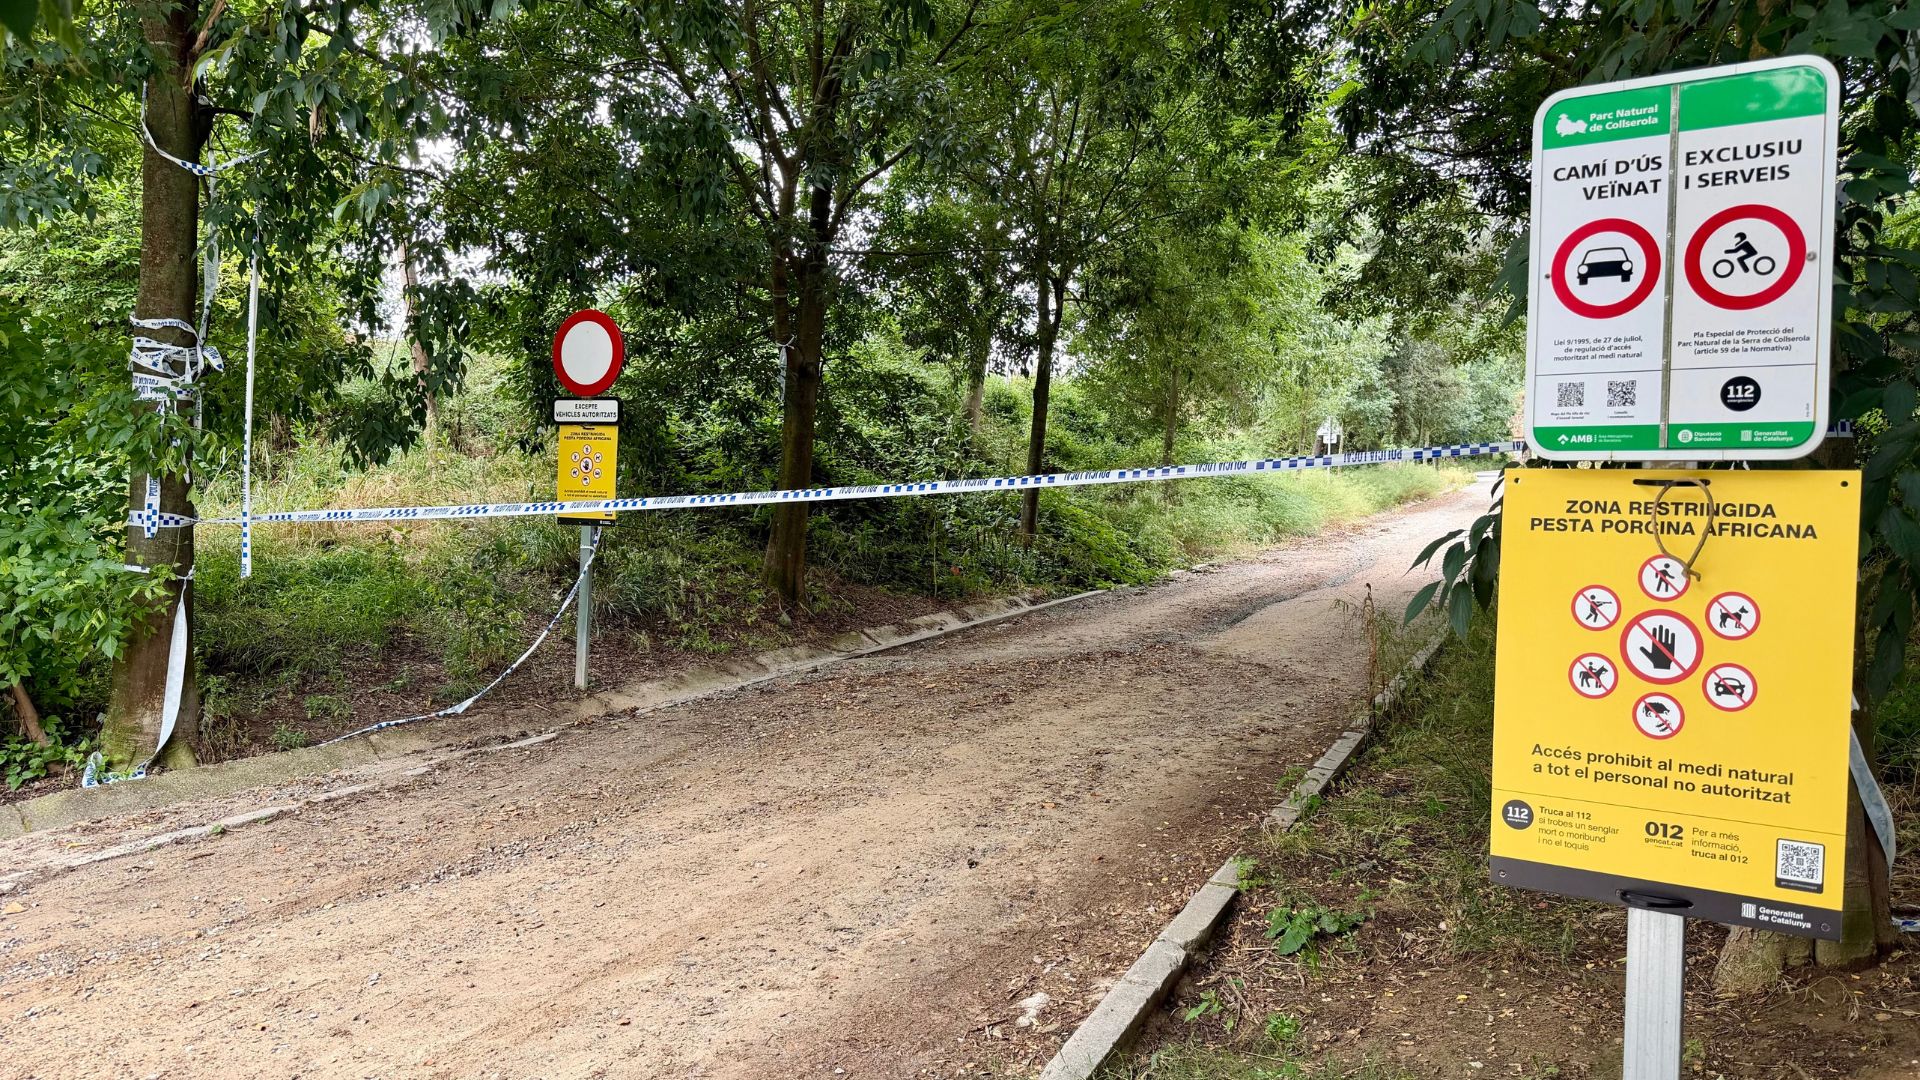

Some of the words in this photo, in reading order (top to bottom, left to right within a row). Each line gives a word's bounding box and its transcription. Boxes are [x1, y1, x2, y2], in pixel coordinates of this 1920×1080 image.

[1590, 112, 1613, 121] Parc
[1616, 104, 1658, 117] Natural
[1589, 123, 1603, 132] de
[1605, 115, 1658, 130] Collserola
[1685, 139, 1802, 167] EXCLUSIU
[1553, 158, 1607, 182] CAMÍ
[1684, 175, 1690, 190] I
[1698, 164, 1790, 189] SERVEIS
[1582, 178, 1662, 201] VEÏNAT
[1694, 339, 1720, 347] Natural
[1773, 334, 1810, 343] Collserola
[1706, 330, 1734, 339] Especial
[1747, 328, 1780, 336] Protecció
[1553, 354, 1589, 362] motoritzat
[1617, 351, 1642, 359] natural
[1574, 345, 1605, 354] regulació
[1694, 347, 1719, 355] (article
[1750, 344, 1792, 353] Normativa)
[1727, 385, 1755, 398] 112
[1570, 434, 1592, 443] AMB
[1566, 499, 1622, 514] ZONA
[1629, 501, 1776, 518] RESTRINGIDA
[1530, 517, 1594, 533] PESTA
[1601, 519, 1695, 536] PORCINA
[1703, 521, 1818, 540] AFRICANA
[1531, 743, 1582, 761] Accés
[1586, 751, 1652, 770] prohibit
[1657, 758, 1672, 771] al
[1678, 761, 1722, 778] medi
[1728, 767, 1794, 786] natural
[1533, 761, 1542, 774] a
[1547, 762, 1570, 777] tot
[1574, 766, 1589, 779] el
[1594, 770, 1668, 789] personal
[1673, 778, 1696, 792] no
[1701, 782, 1792, 804] autoritzat
[1507, 806, 1529, 820] 112
[1539, 806, 1564, 817] Truca
[1566, 810, 1574, 818] al
[1576, 812, 1592, 820] 112
[1538, 816, 1546, 824] si
[1547, 817, 1574, 829] trobes
[1575, 822, 1586, 830] un
[1588, 823, 1619, 836] senglar
[1645, 821, 1684, 840] 012
[1538, 827, 1557, 836] mort
[1566, 831, 1606, 843] moribund
[1692, 827, 1709, 837] Per
[1719, 832, 1740, 841] més
[1542, 837, 1553, 845] no
[1554, 839, 1563, 847] el
[1564, 840, 1590, 852] toquis
[1644, 837, 1683, 847] gencat.cat
[1691, 838, 1742, 854] informació,
[1691, 849, 1717, 860] truca
[1719, 853, 1728, 861] al
[1730, 854, 1749, 864] 012
[1759, 906, 1804, 920] Generalitat
[1758, 914, 1769, 922] de
[1770, 916, 1812, 929] Catalunya
